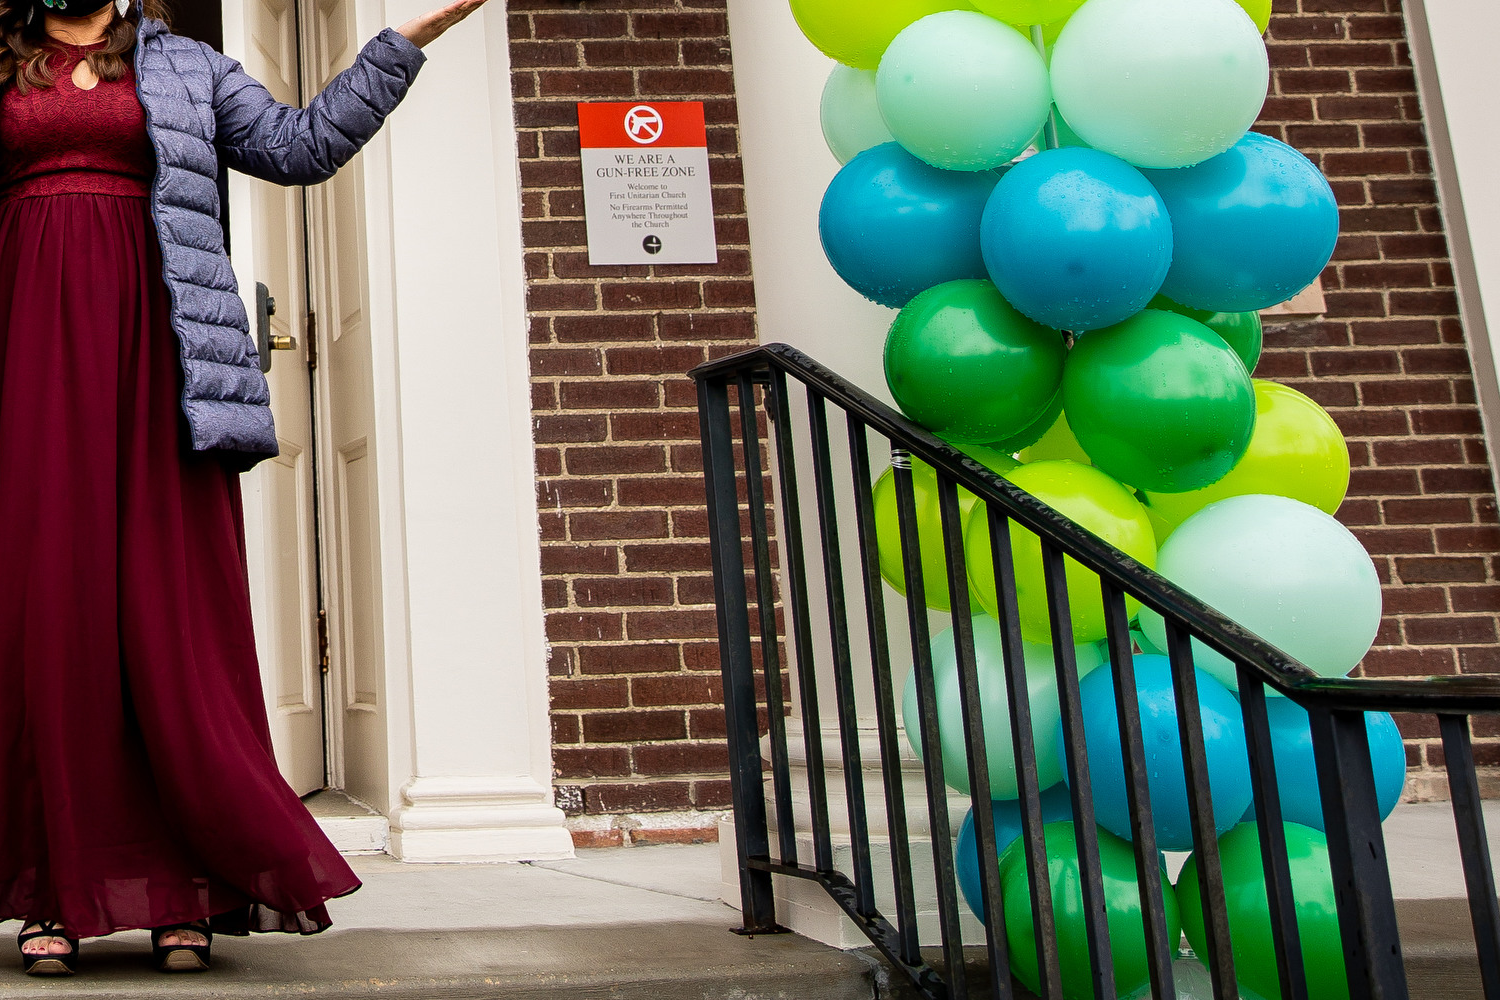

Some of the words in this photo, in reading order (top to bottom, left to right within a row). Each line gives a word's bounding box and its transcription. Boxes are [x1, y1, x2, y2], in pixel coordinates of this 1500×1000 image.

[614, 154, 634, 164] WE
[638, 154, 664, 164] ARE
[667, 154, 676, 164] A
[596, 167, 659, 178] GUN-FREE
[661, 166, 696, 177] ZONE
[661, 191, 687, 199] Church
[622, 203, 653, 211] Firearms
[611, 212, 646, 220] Anywhere
[649, 212, 689, 220] Throughout
[644, 220, 670, 228] Church
